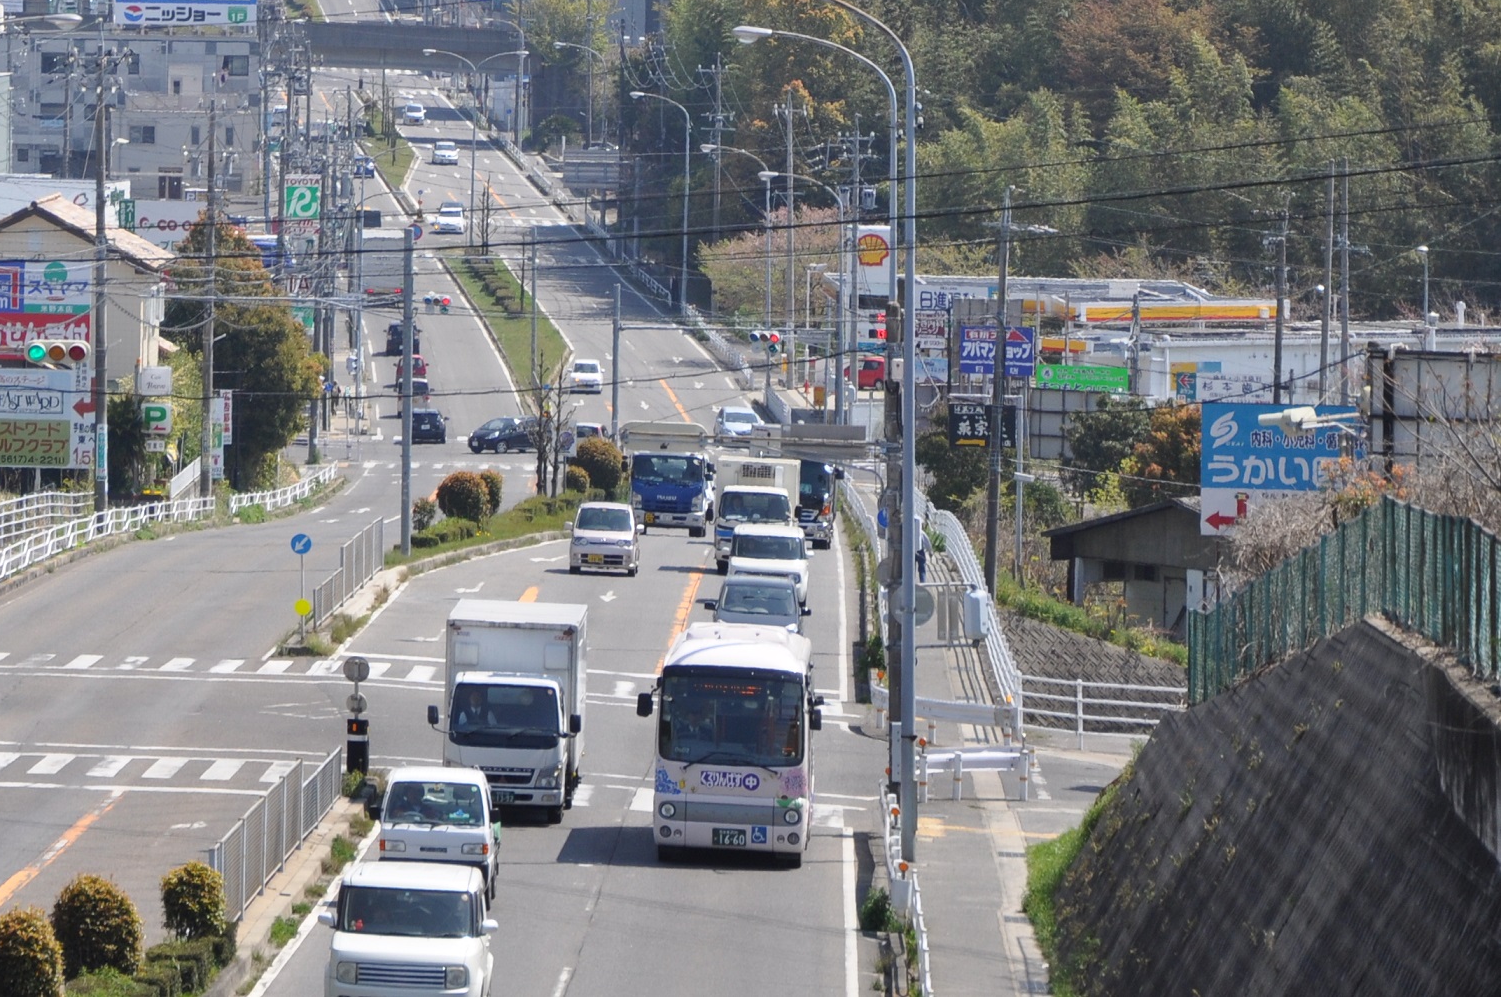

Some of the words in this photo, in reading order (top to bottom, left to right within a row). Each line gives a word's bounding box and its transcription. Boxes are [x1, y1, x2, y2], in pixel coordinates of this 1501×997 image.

[144, 6, 222, 22] ニッショー
[231, 13, 245, 23] 1F
[285, 178, 320, 186] TOYOTA
[961, 341, 1032, 359] アパマンョップ
[145, 406, 167, 431] P
[701, 772, 741, 788] くるりんばす
[719, 834, 745, 845] 16-60
